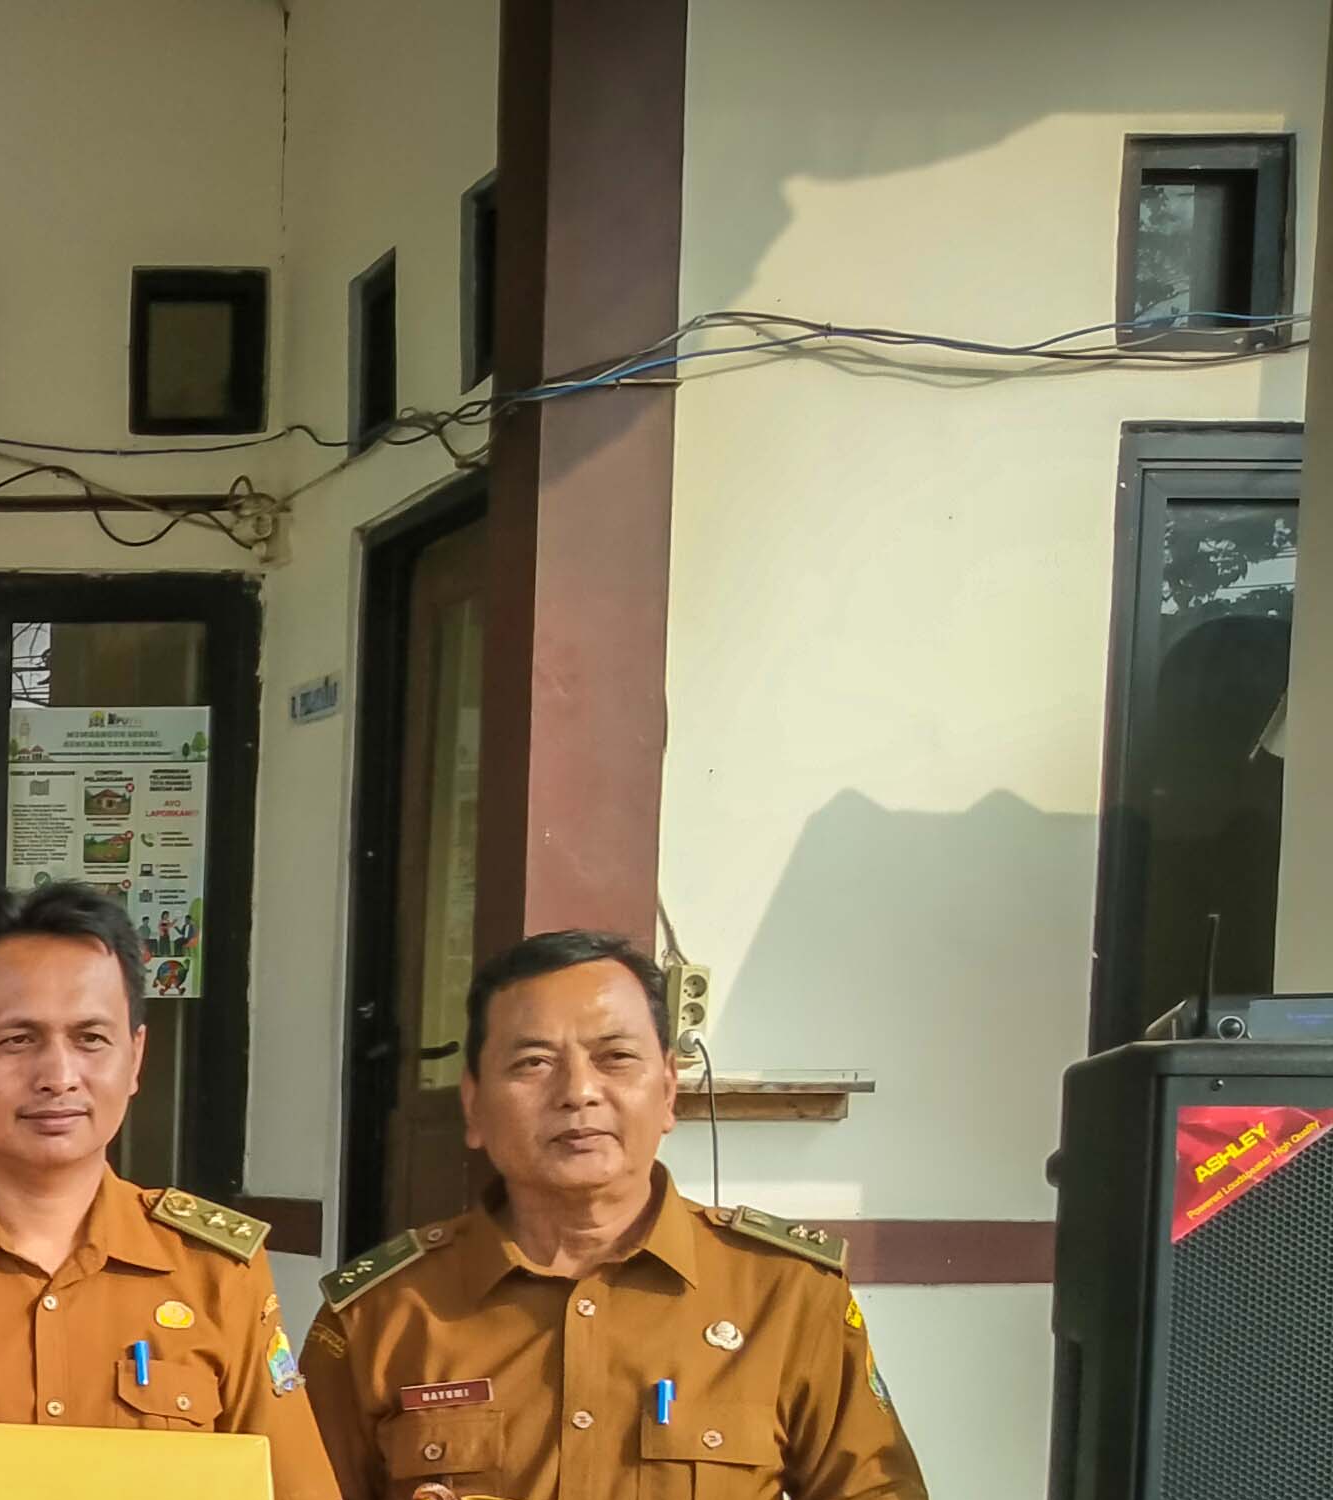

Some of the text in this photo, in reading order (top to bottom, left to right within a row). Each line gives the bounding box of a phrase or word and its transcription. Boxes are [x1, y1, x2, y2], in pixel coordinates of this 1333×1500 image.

[1186, 1190, 1225, 1219] Powered
[1271, 1141, 1293, 1159] High
[1290, 1120, 1322, 1143] Quality
[1194, 1121, 1267, 1184] ASHLEY
